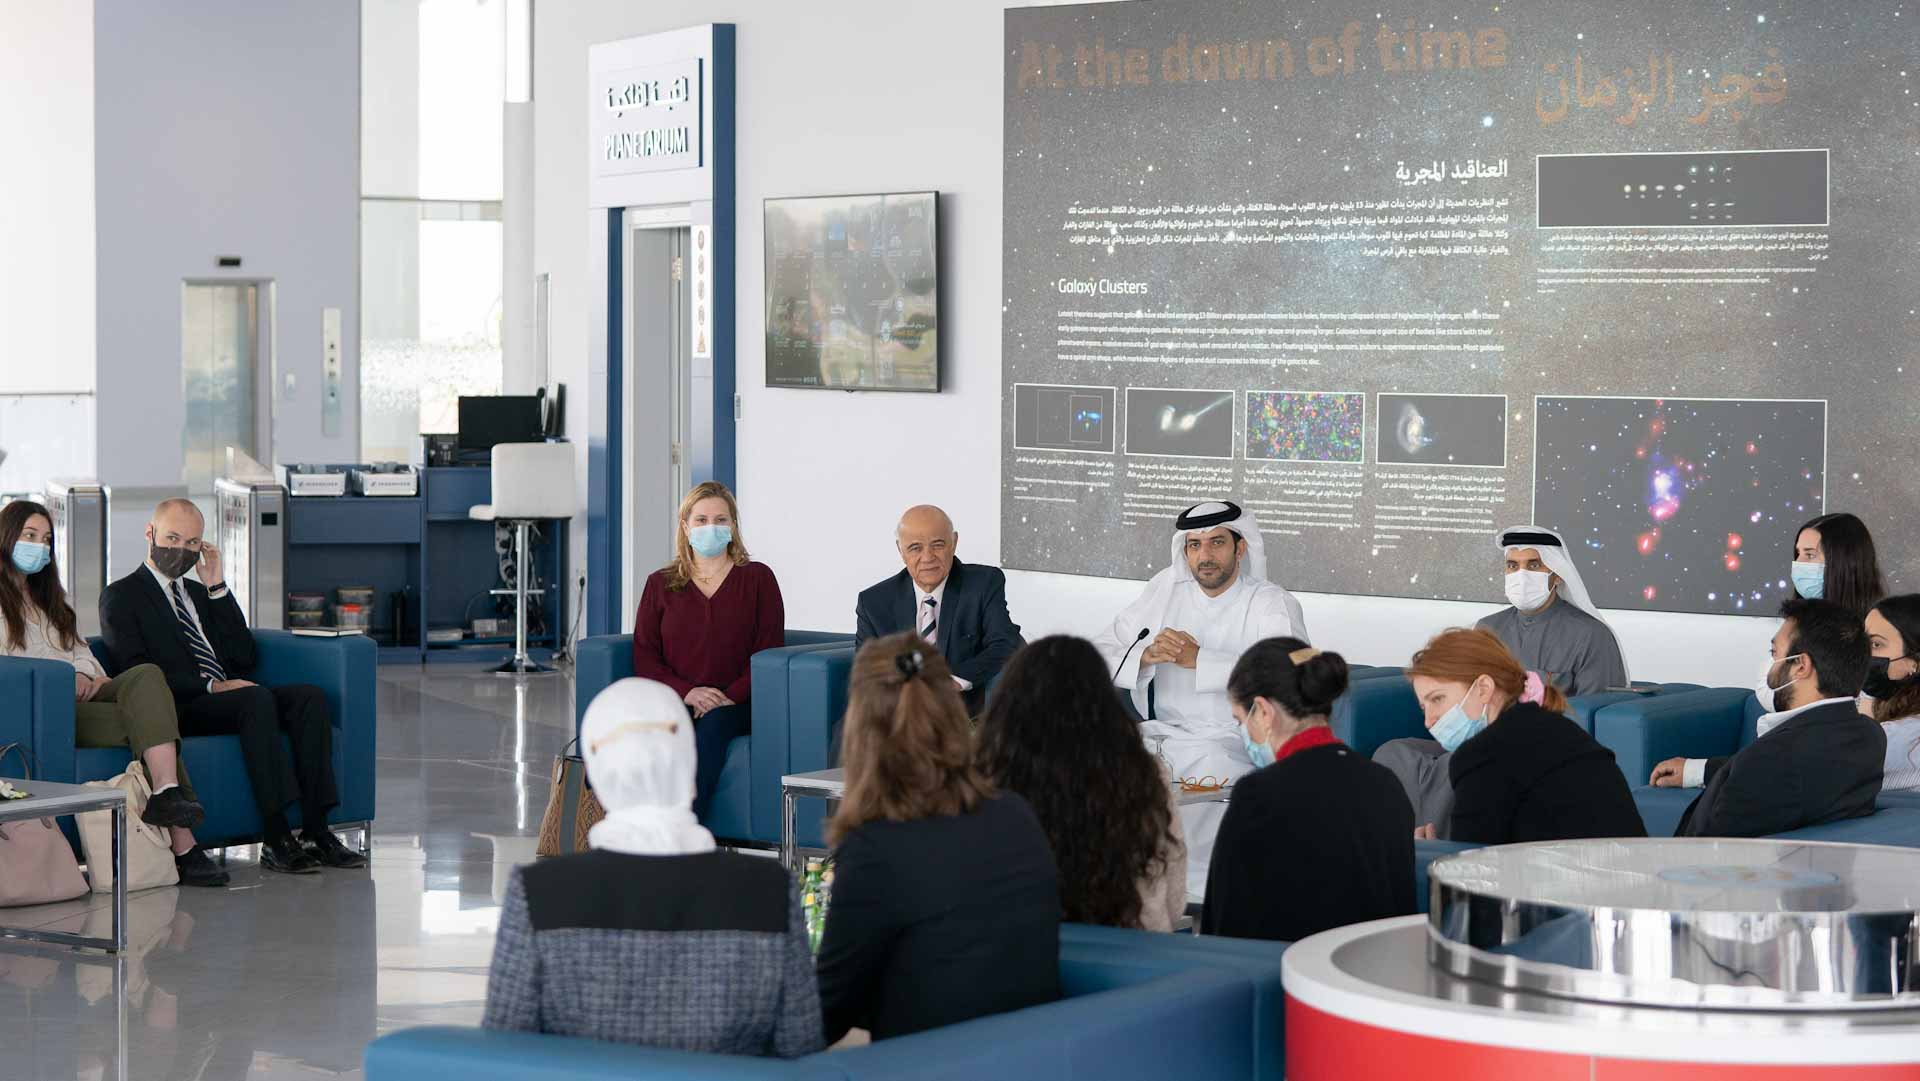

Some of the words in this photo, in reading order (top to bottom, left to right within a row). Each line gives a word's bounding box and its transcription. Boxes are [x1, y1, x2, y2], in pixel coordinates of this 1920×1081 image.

[1018, 41, 1066, 89] At
[1073, 37, 1151, 87] the
[1162, 32, 1296, 82] dawn
[1307, 22, 1362, 76] of
[1376, 19, 1508, 72] time
[1535, 48, 1674, 127] الزمان
[1687, 48, 1790, 126] فجر
[604, 125, 689, 161] PLANETARIUM
[1396, 160, 1445, 185] المجرية
[1451, 158, 1507, 185] العناقيد
[1058, 278, 1098, 296] Galaxy
[1099, 279, 1148, 294] Clusters
